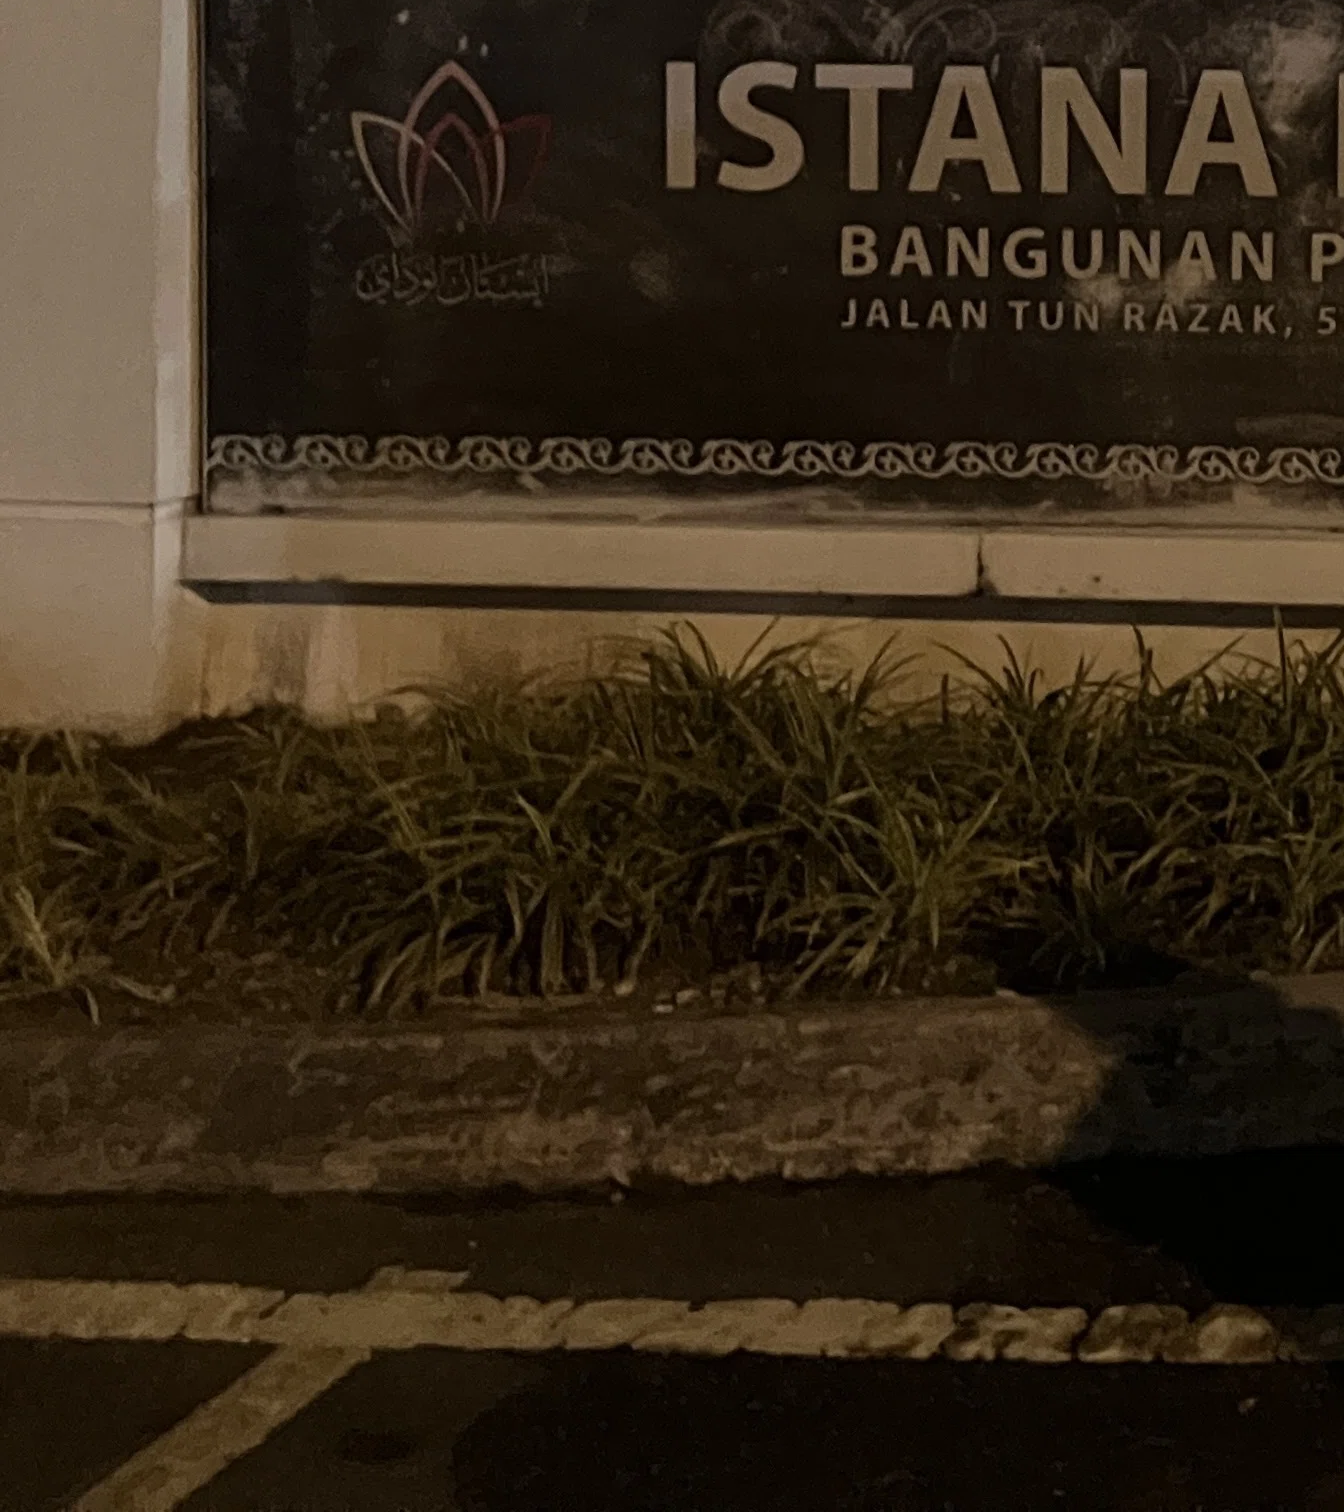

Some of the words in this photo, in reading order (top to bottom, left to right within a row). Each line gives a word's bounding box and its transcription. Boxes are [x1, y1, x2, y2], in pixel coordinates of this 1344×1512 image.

[665, 61, 1278, 197] ISTANA
[840, 225, 1276, 281] BANGUNAN
[840, 300, 990, 330] JALAN
[1007, 301, 1101, 331] TUN
[1122, 303, 1294, 339] RAZAK,
